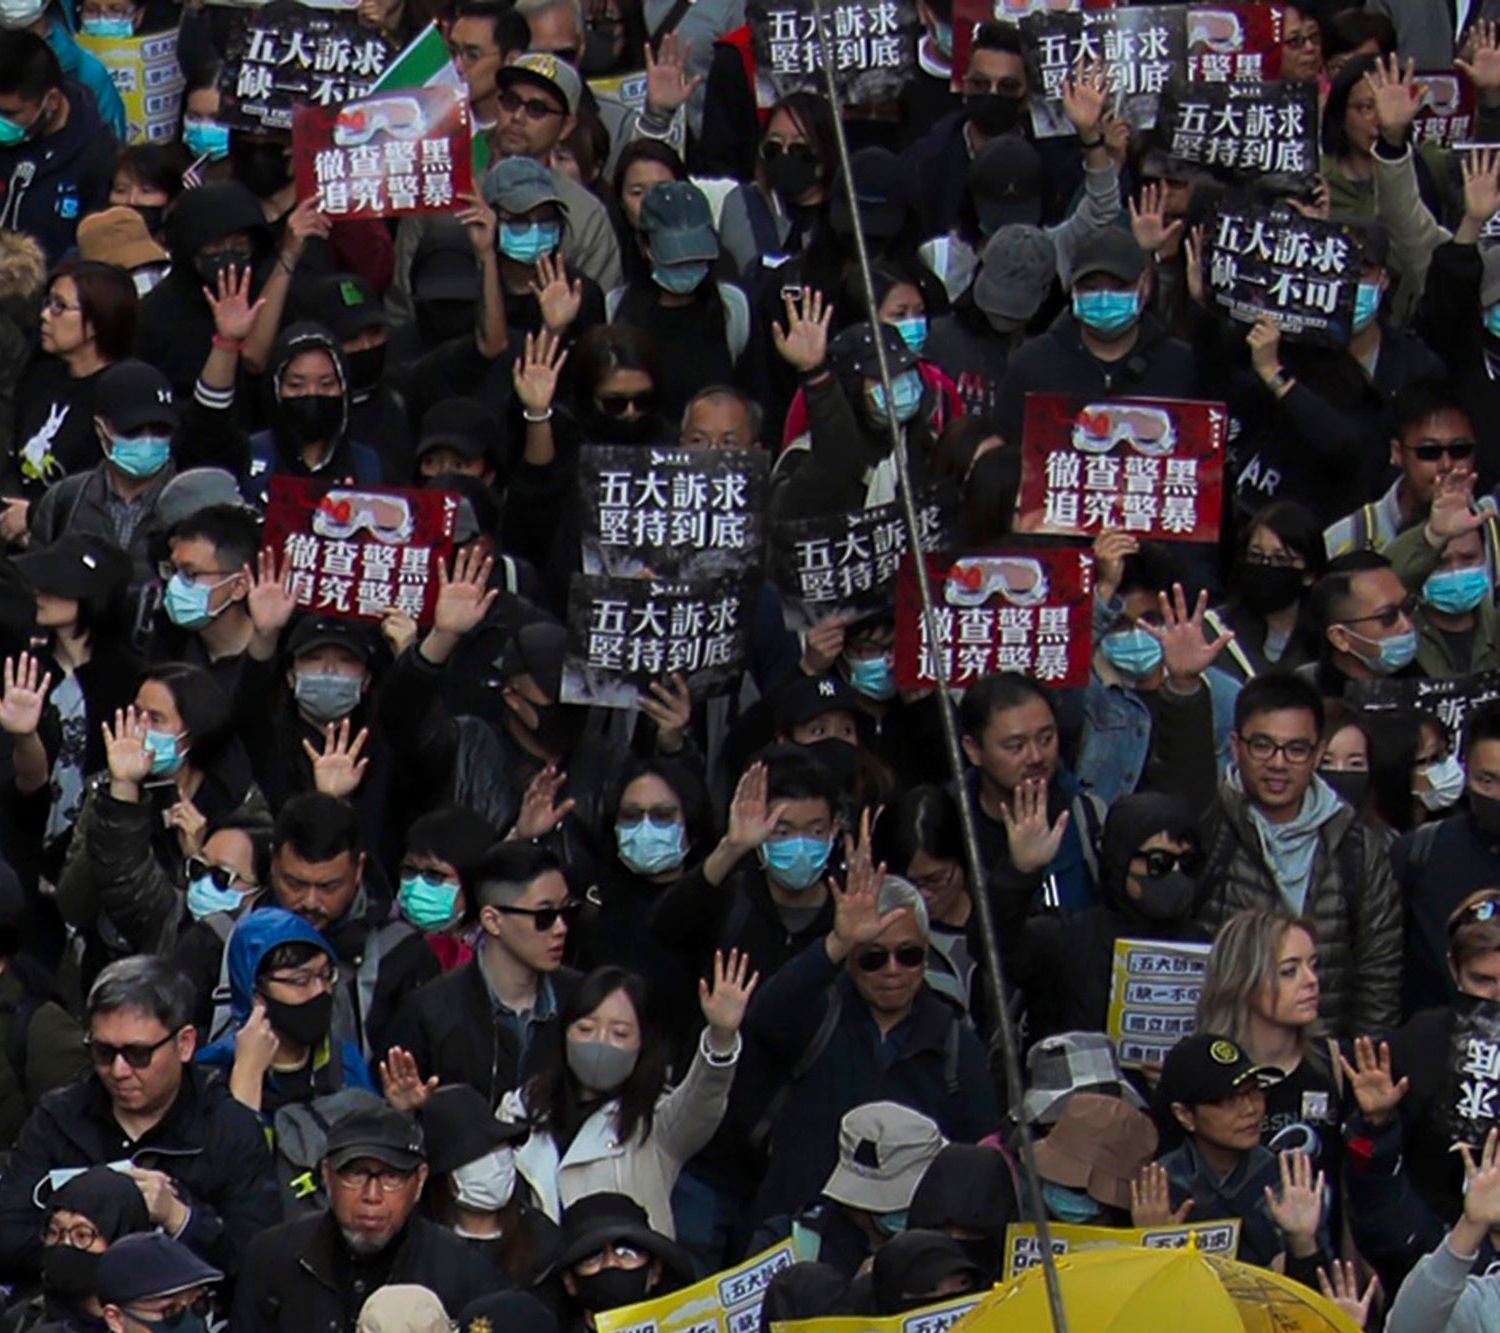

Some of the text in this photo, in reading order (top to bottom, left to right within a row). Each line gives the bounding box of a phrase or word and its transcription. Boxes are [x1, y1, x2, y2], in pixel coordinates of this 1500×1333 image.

[244, 28, 386, 76] 五大訴求
[1039, 27, 1170, 67] 五大訴求
[1187, 53, 1262, 83] 警黑
[1042, 59, 1170, 99] 堅到底
[1178, 101, 1305, 139] 五大訴求
[314, 137, 451, 181] 徹查警黑
[1172, 129, 1306, 174] 堅持到底
[315, 167, 455, 214] 追究警暴
[1217, 215, 1350, 274] 五大訴求
[1210, 250, 1345, 315] 缺一不可
[598, 472, 748, 511] 五大訴求
[1044, 450, 1199, 496] 徹查警黑
[598, 507, 748, 549] 堅持到底
[1042, 489, 1198, 533] 追究警暴
[283, 533, 430, 586] 徹查警黑
[589, 598, 741, 640] 五大訴求
[916, 605, 1071, 645] 徹查警黑
[586, 633, 735, 675] 堅持到底
